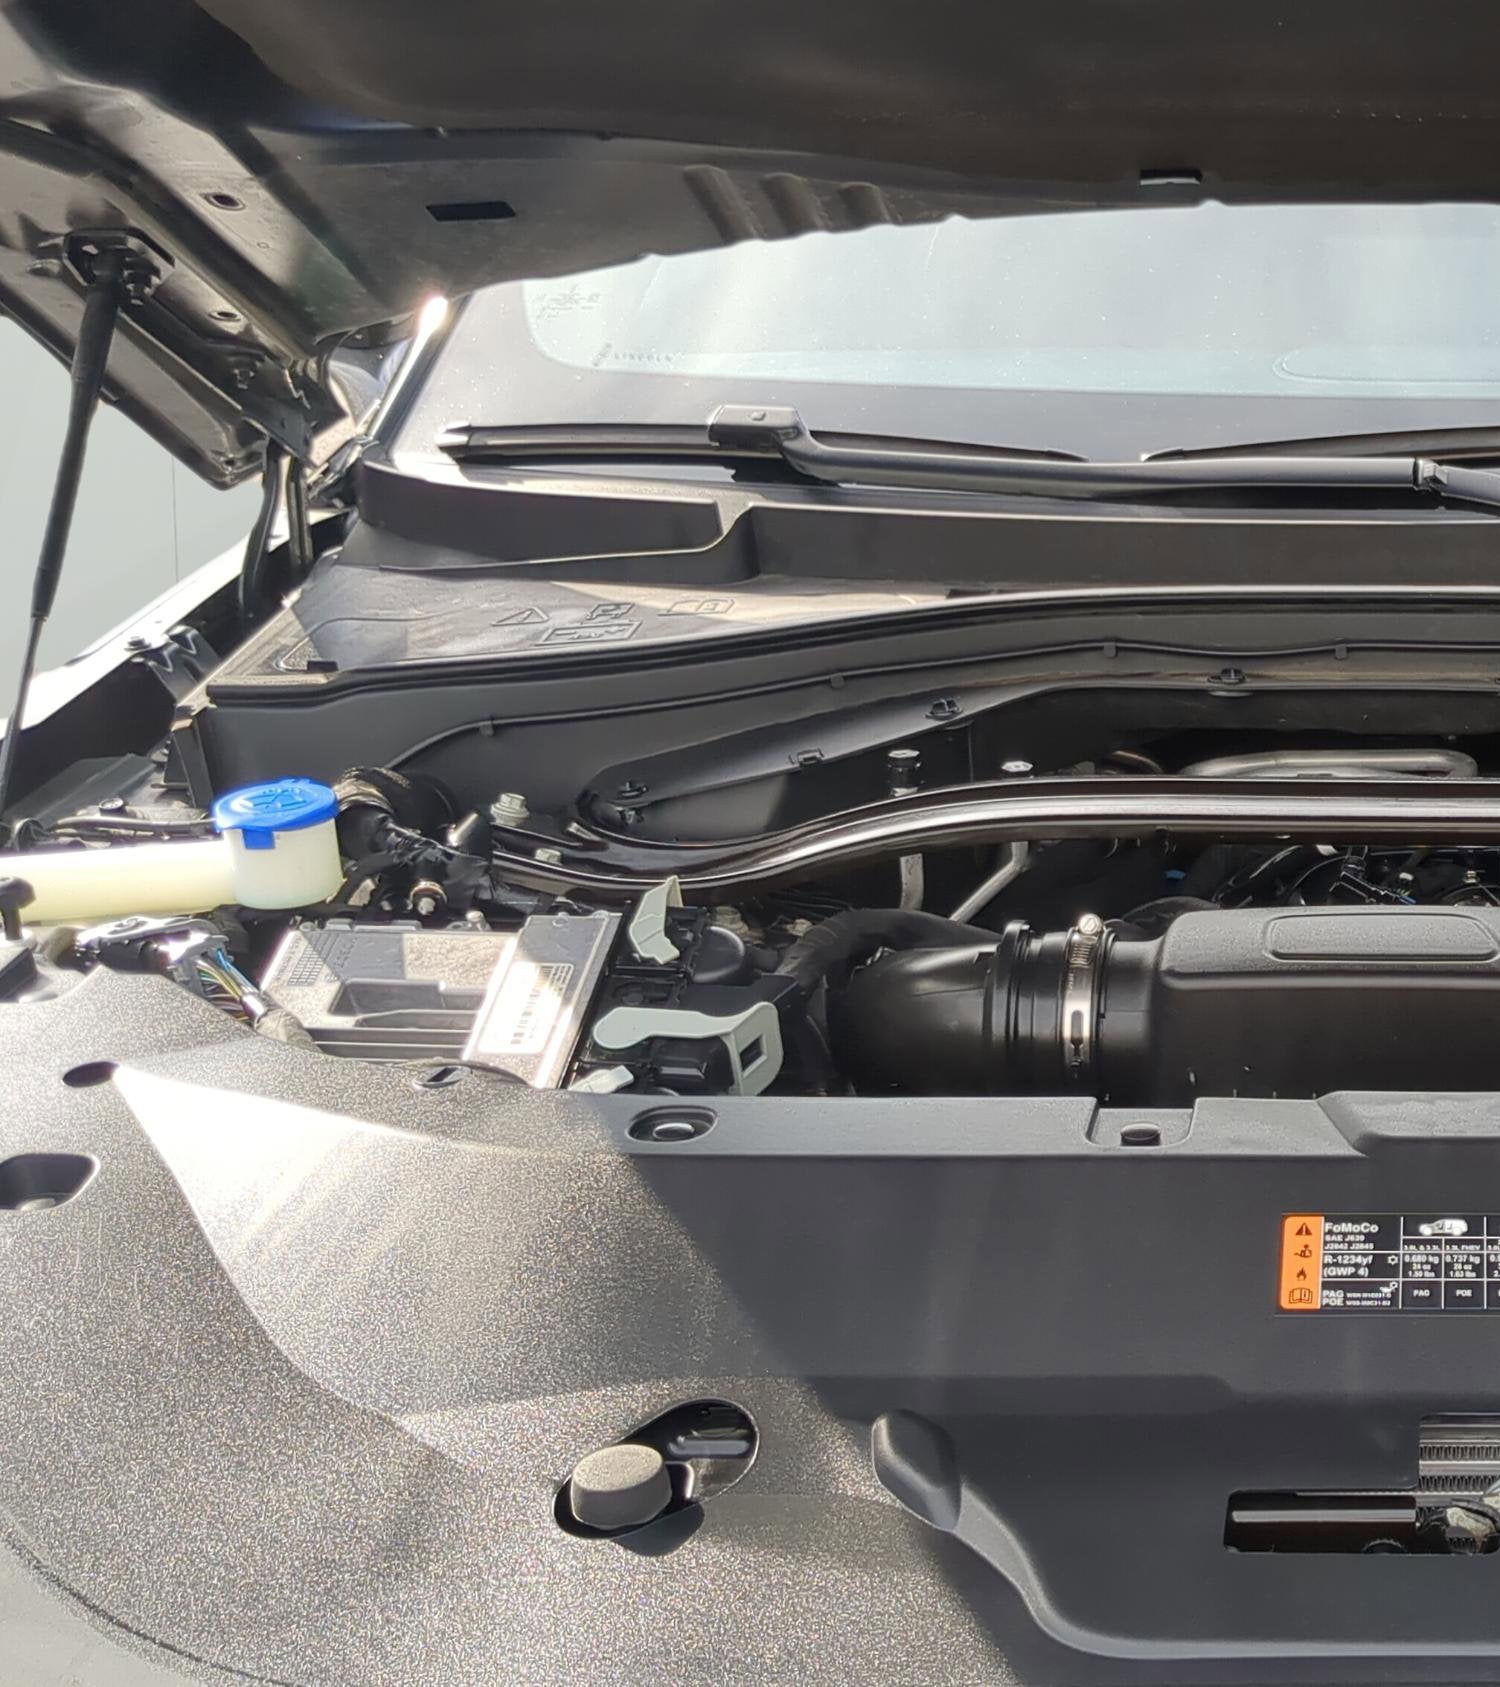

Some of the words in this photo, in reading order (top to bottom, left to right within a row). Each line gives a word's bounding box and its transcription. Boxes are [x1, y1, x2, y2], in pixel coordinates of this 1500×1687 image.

[1325, 1222, 1379, 1233] FoMoCo
[1324, 1254, 1373, 1265] R-1234yf
[1428, 1254, 1439, 1264] kg
[1445, 1254, 1467, 1262] 0.737
[1469, 1254, 1480, 1264] kg
[1323, 1266, 1356, 1277] (GWP
[1357, 1266, 1369, 1277] 4)
[1322, 1290, 1344, 1298] PAG
[1413, 1289, 1430, 1297] PAG
[1456, 1289, 1472, 1297] POE
[1322, 1298, 1344, 1306] POE
